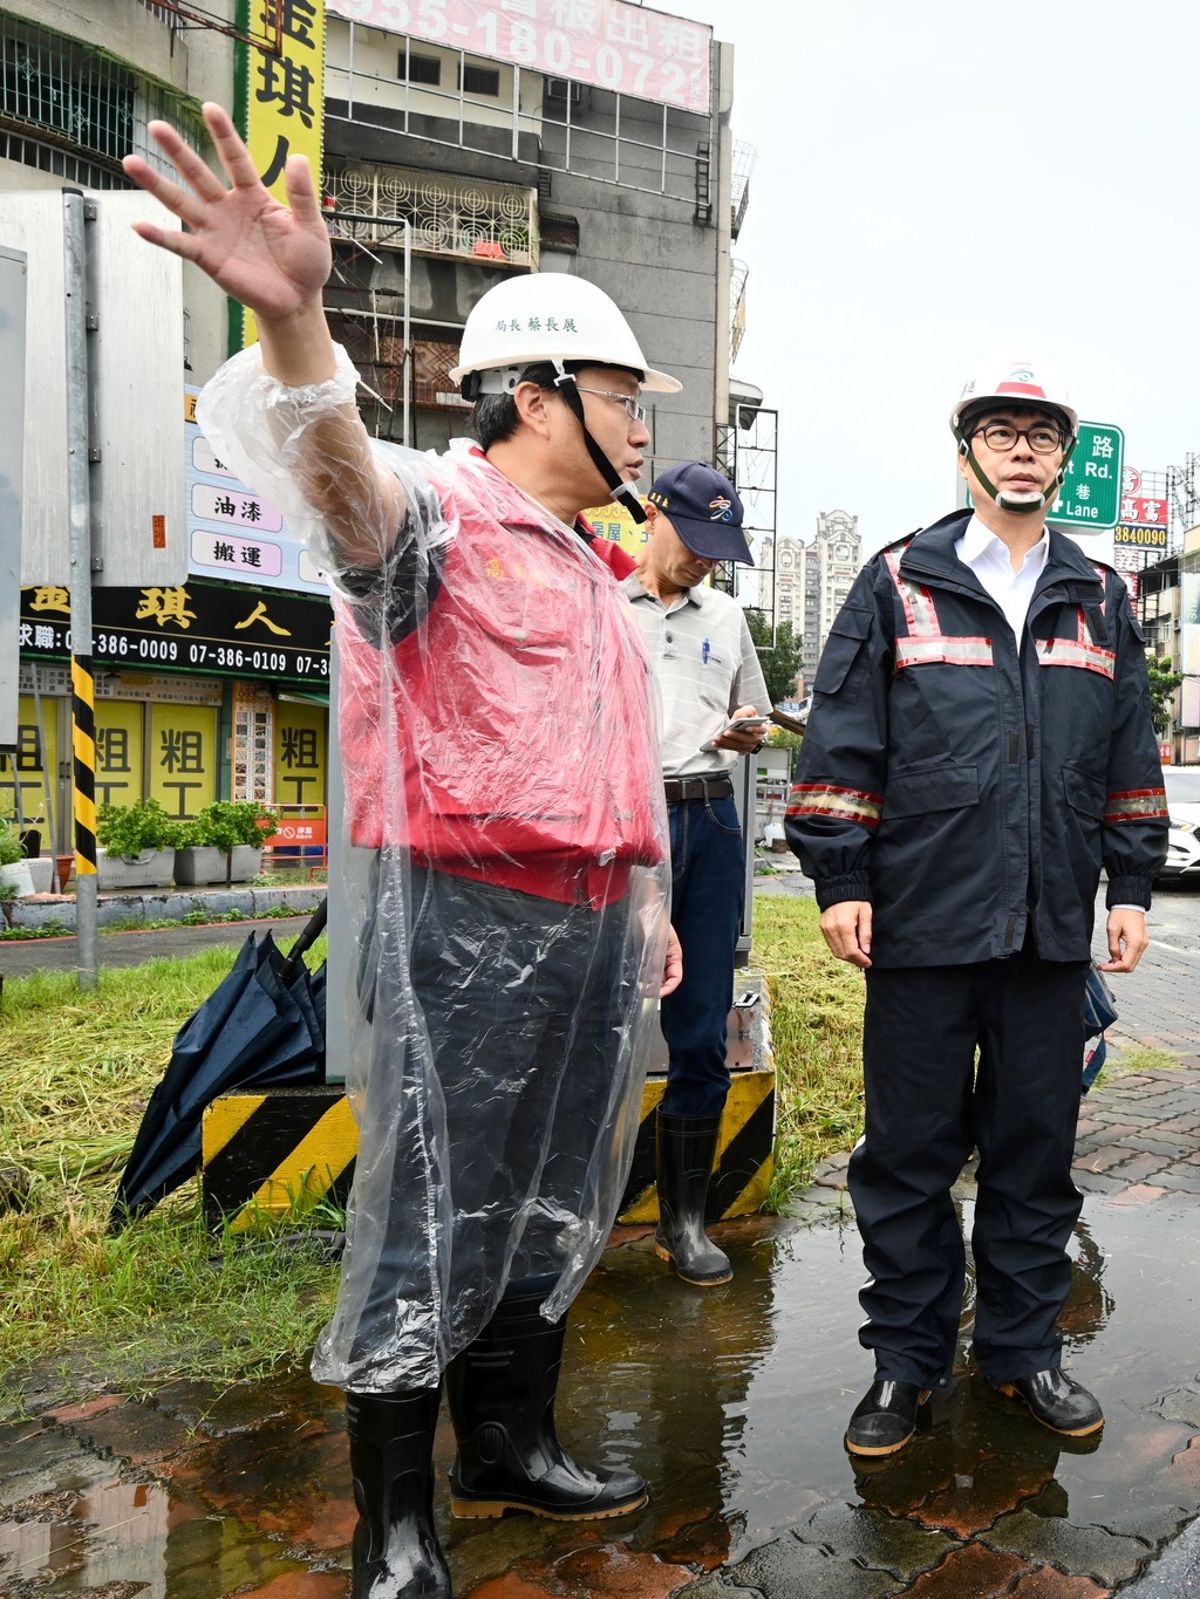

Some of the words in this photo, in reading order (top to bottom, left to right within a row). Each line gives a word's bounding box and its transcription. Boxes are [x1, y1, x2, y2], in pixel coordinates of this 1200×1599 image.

[495, 318, 522, 332] 局長
[527, 316, 578, 333] 蔡長展
[1092, 435, 1114, 459] 路
[1085, 462, 1113, 480] Rd.
[1075, 483, 1091, 500] 巷
[214, 496, 263, 522] 油漆
[1066, 501, 1099, 519] Lane
[1115, 526, 1166, 546] 3840090
[213, 541, 263, 567] 搬運
[190, 644, 286, 671] 07-386-0109
[280, 727, 319, 812] 粗工
